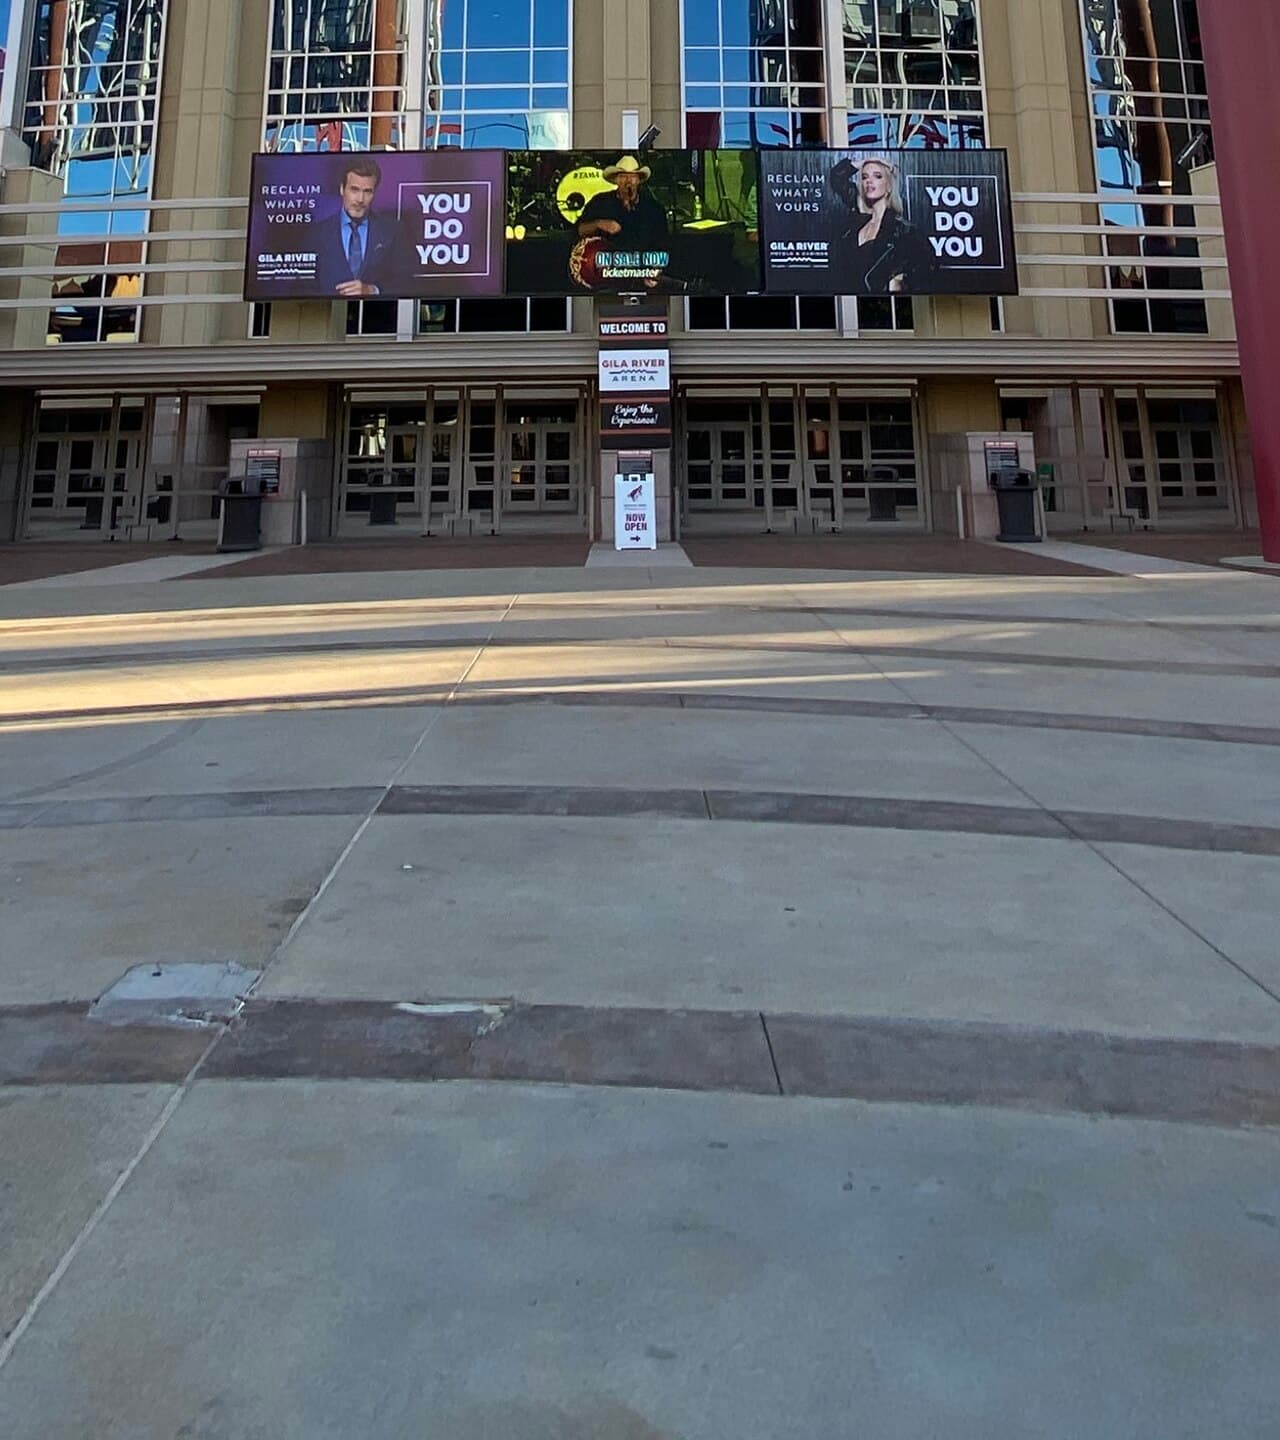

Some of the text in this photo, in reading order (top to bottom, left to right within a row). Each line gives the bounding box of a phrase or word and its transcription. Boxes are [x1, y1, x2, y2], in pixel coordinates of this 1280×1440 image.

[767, 174, 826, 184] RECLAIM
[262, 184, 321, 196] RECLAIM
[771, 188, 822, 198] WHAT'S
[925, 186, 980, 207] YOU
[264, 199, 316, 209] WHAT'S
[417, 193, 472, 214] YOU
[775, 202, 819, 212] YOURS
[267, 213, 312, 224] YOURS
[935, 211, 974, 232] DO
[424, 219, 464, 240] DO
[770, 241, 828, 251] GILA RIVER
[928, 236, 983, 258] YOU
[258, 252, 317, 263] GILA RIVER
[416, 243, 471, 265] YOU
[595, 251, 669, 266] ON SALE NOW
[602, 267, 661, 278] ticketmaster
[600, 322, 666, 334] WELCOME TO
[602, 359, 665, 368] GILA RIVER
[612, 375, 656, 383] ARENA
[615, 404, 638, 417] Enjoy
[611, 414, 658, 428] Experience!
[626, 513, 646, 522] NOW
[624, 522, 647, 532] OPEN
